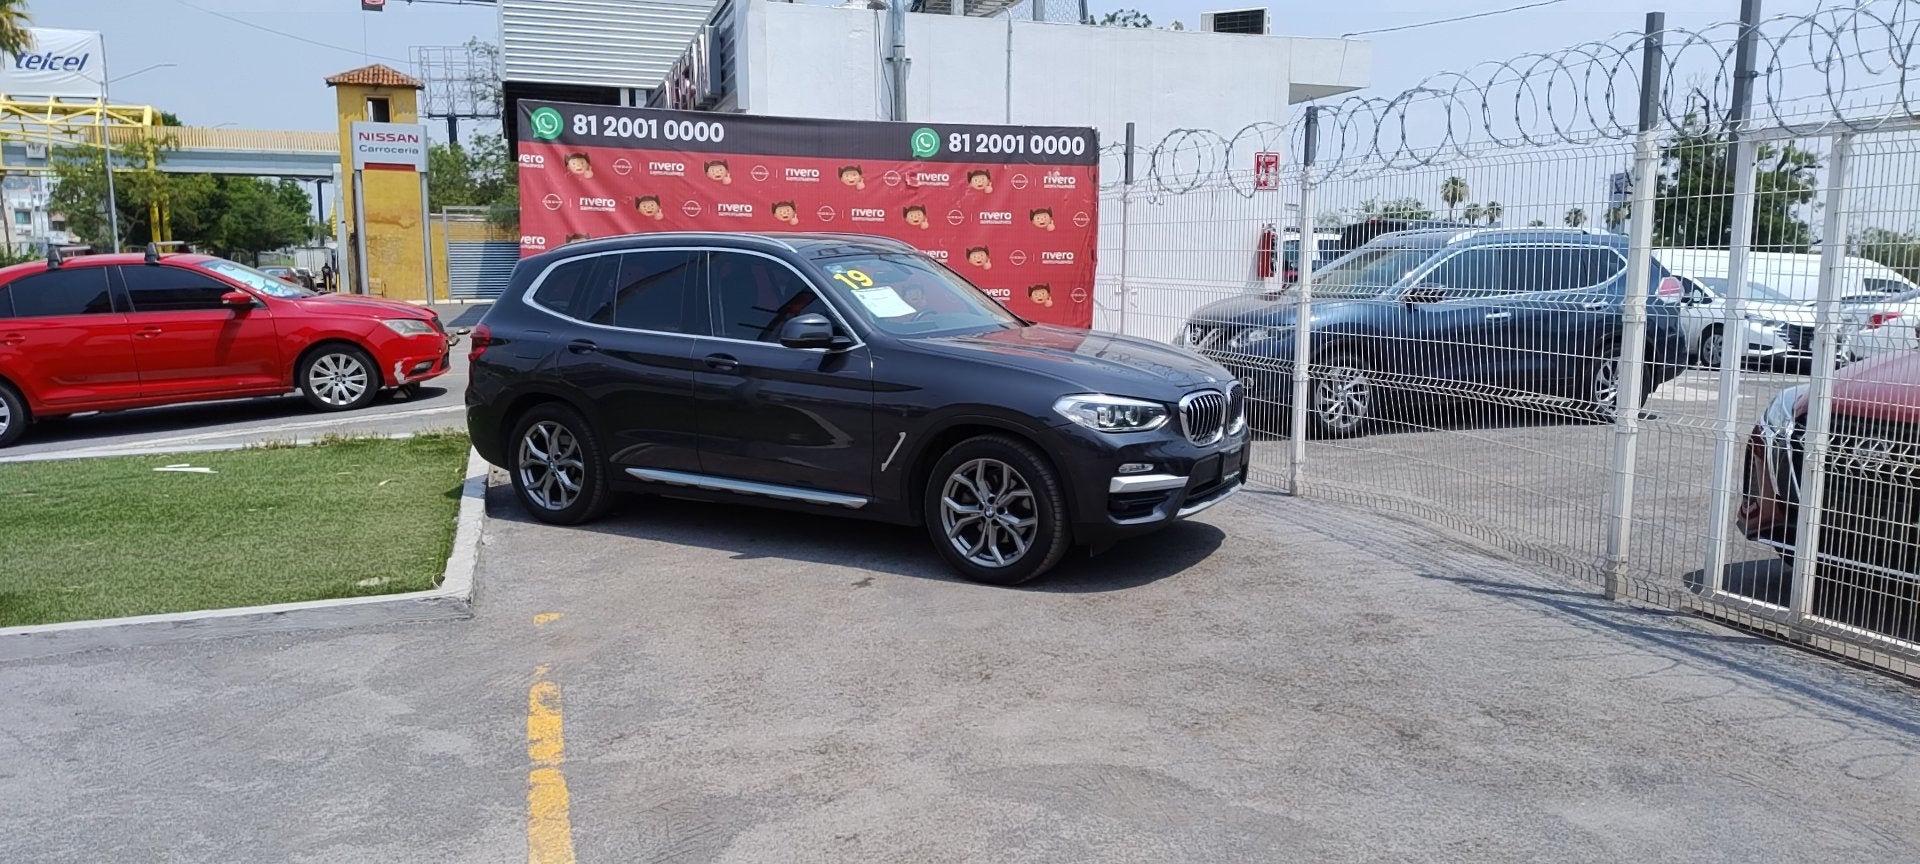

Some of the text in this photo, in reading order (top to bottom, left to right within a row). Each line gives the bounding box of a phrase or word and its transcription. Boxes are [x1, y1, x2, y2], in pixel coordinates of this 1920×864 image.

[16, 52, 89, 71] telcel
[573, 114, 725, 142] 81 2001 0000
[359, 132, 419, 143] NISSAN
[359, 144, 419, 154] Carroceria
[948, 133, 1085, 156] 81 2001 0000
[649, 161, 685, 172] rivero
[785, 167, 819, 177] rivero
[916, 172, 949, 182] rivero
[579, 197, 616, 208] rivero
[718, 203, 752, 213] rivero
[851, 208, 885, 217] rivero
[979, 211, 1012, 220] rivero
[1042, 251, 1074, 260] rivero
[833, 269, 873, 290] 19
